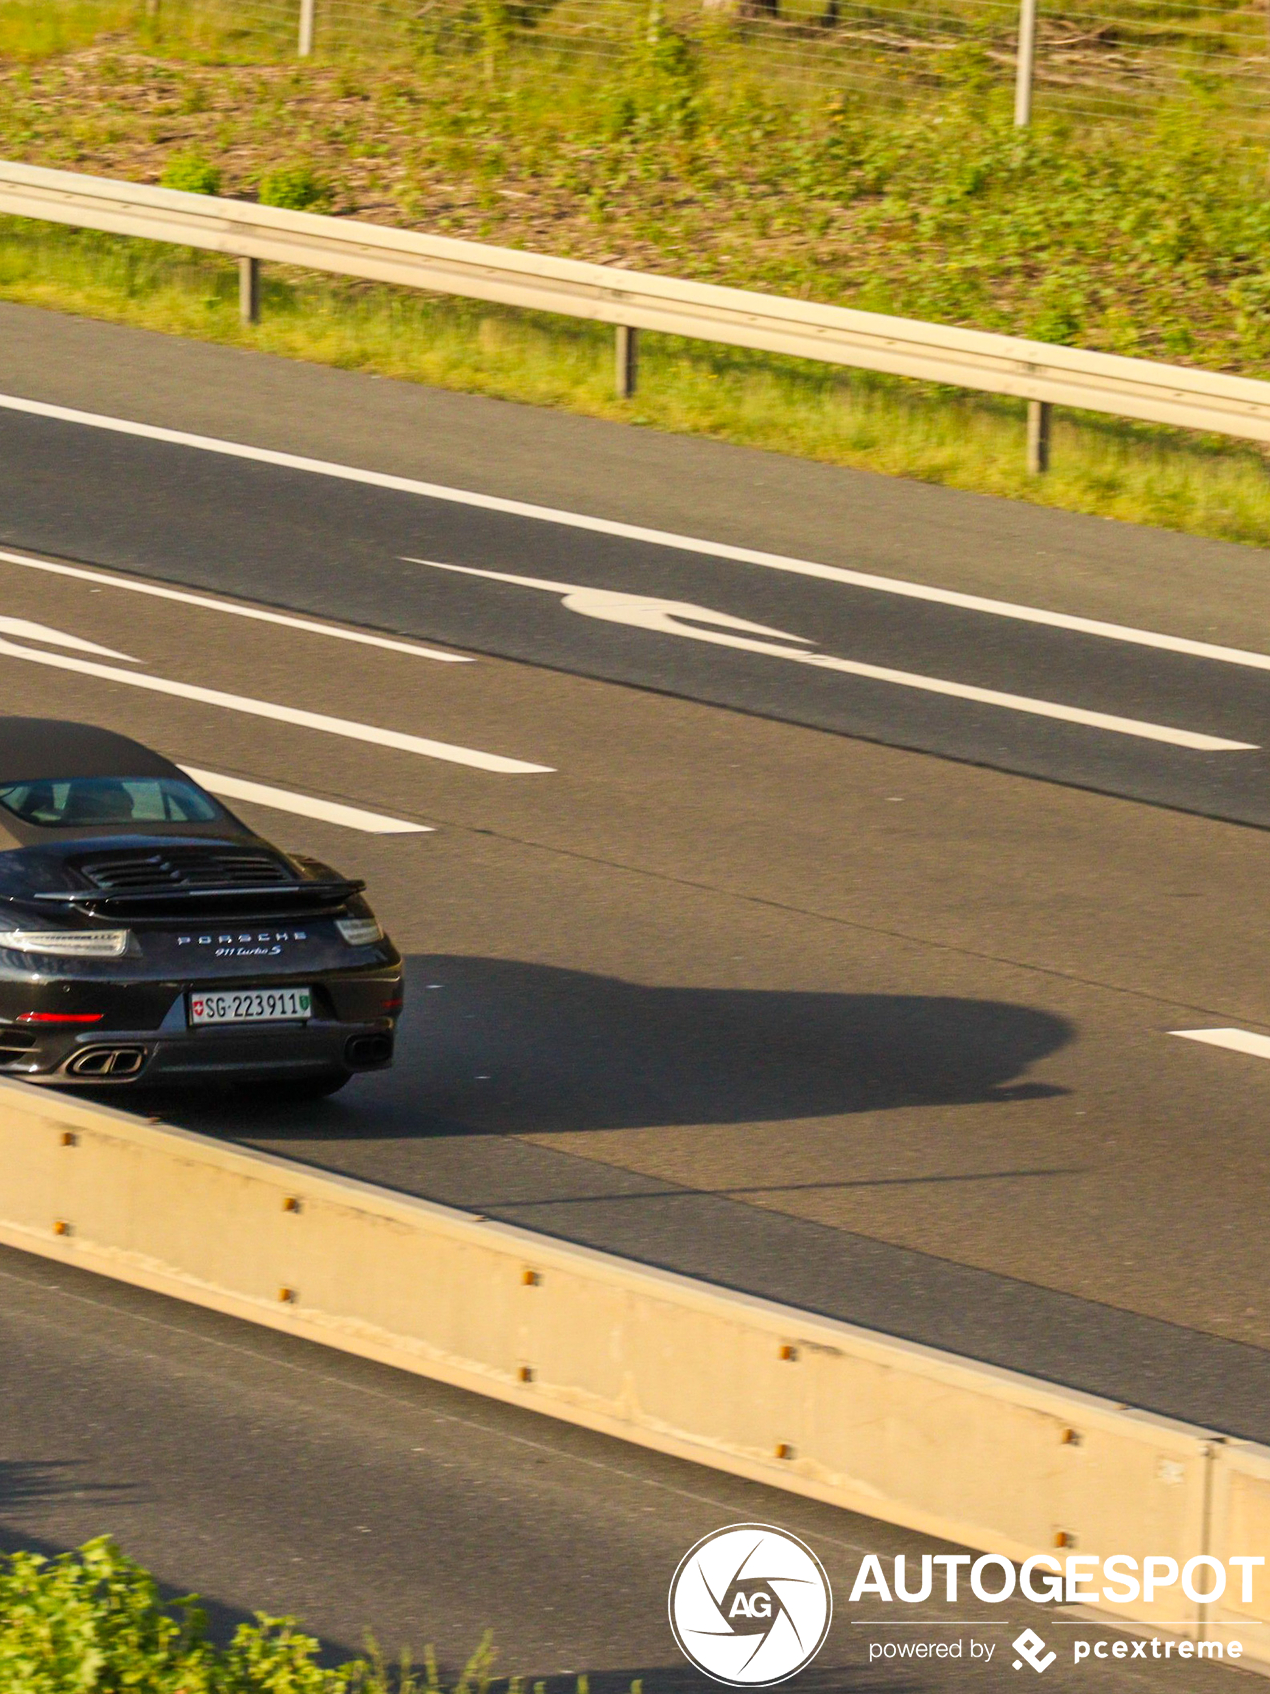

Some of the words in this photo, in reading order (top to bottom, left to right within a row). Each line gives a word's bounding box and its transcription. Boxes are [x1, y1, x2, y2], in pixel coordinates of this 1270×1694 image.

[177, 931, 308, 946] PORSCHE
[215, 947, 235, 957] 911
[268, 945, 282, 956] S
